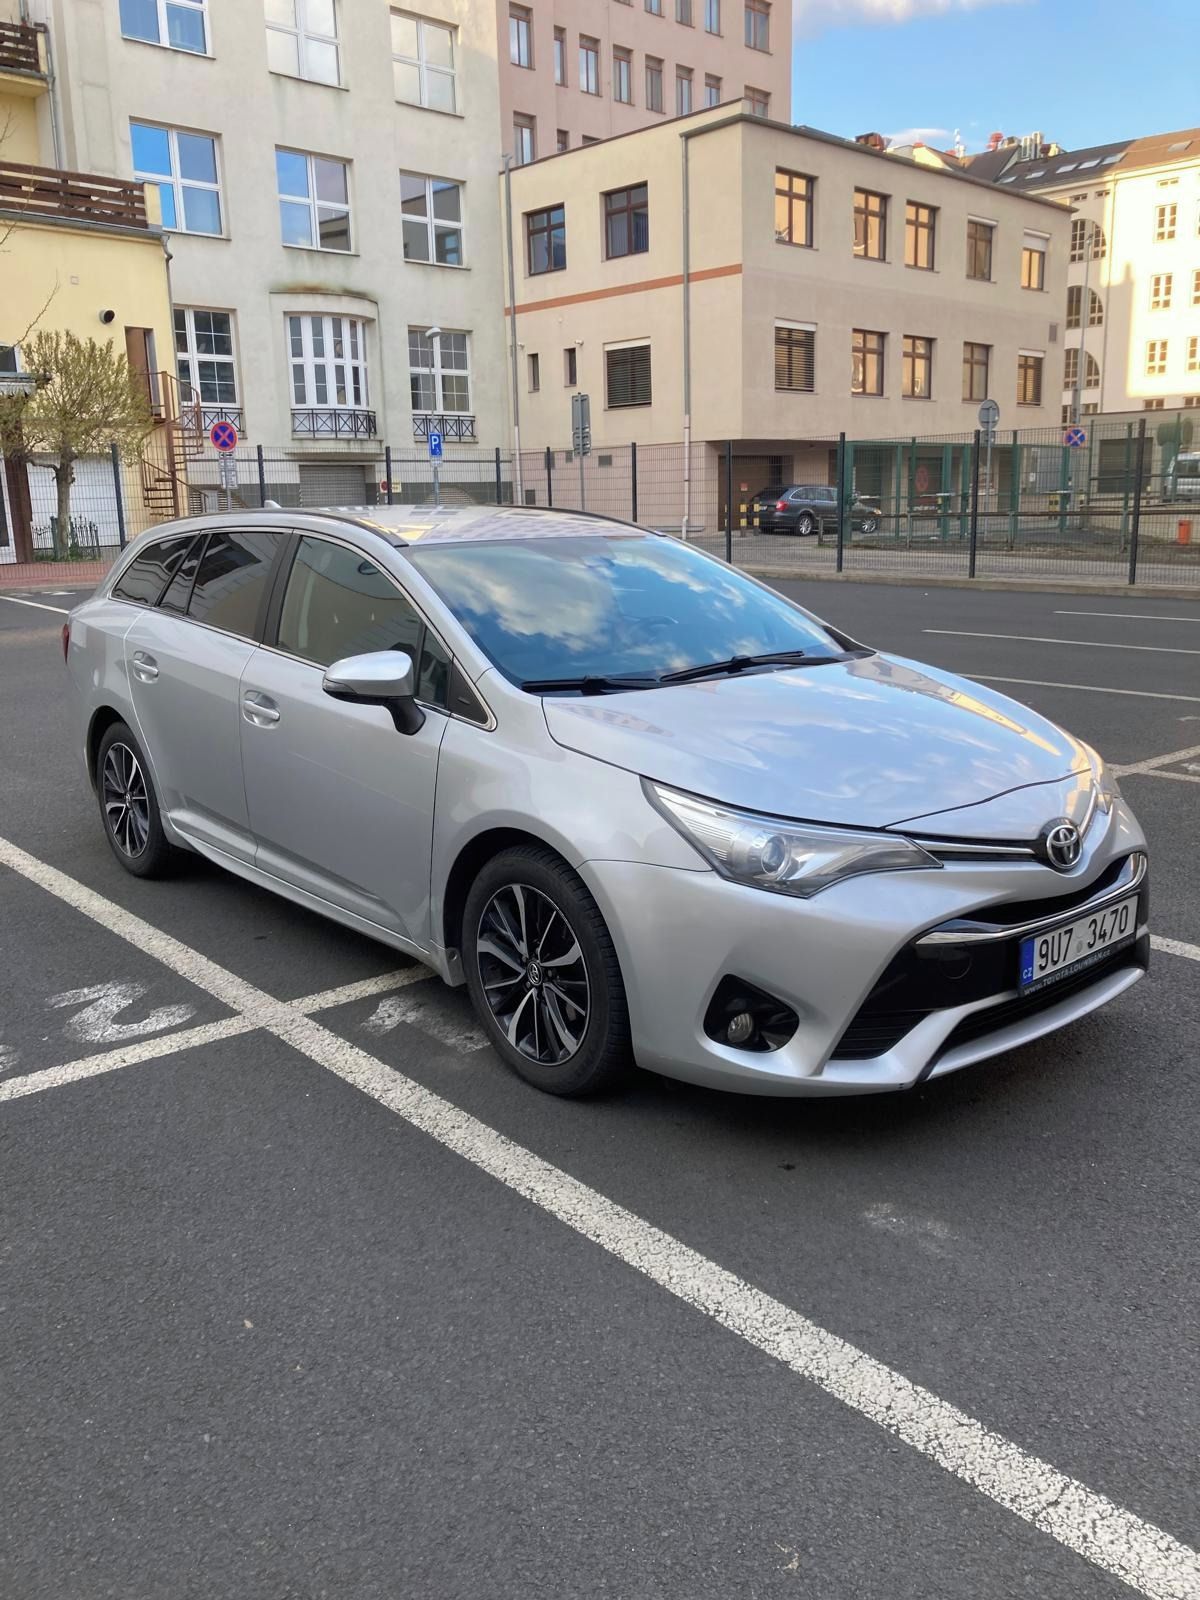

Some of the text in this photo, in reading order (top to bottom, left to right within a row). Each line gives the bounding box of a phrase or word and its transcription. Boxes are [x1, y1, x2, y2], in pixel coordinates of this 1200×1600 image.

[431, 435, 439, 449] P
[1038, 904, 1129, 971] 9U7 3470
[1022, 966, 1032, 979] CZ
